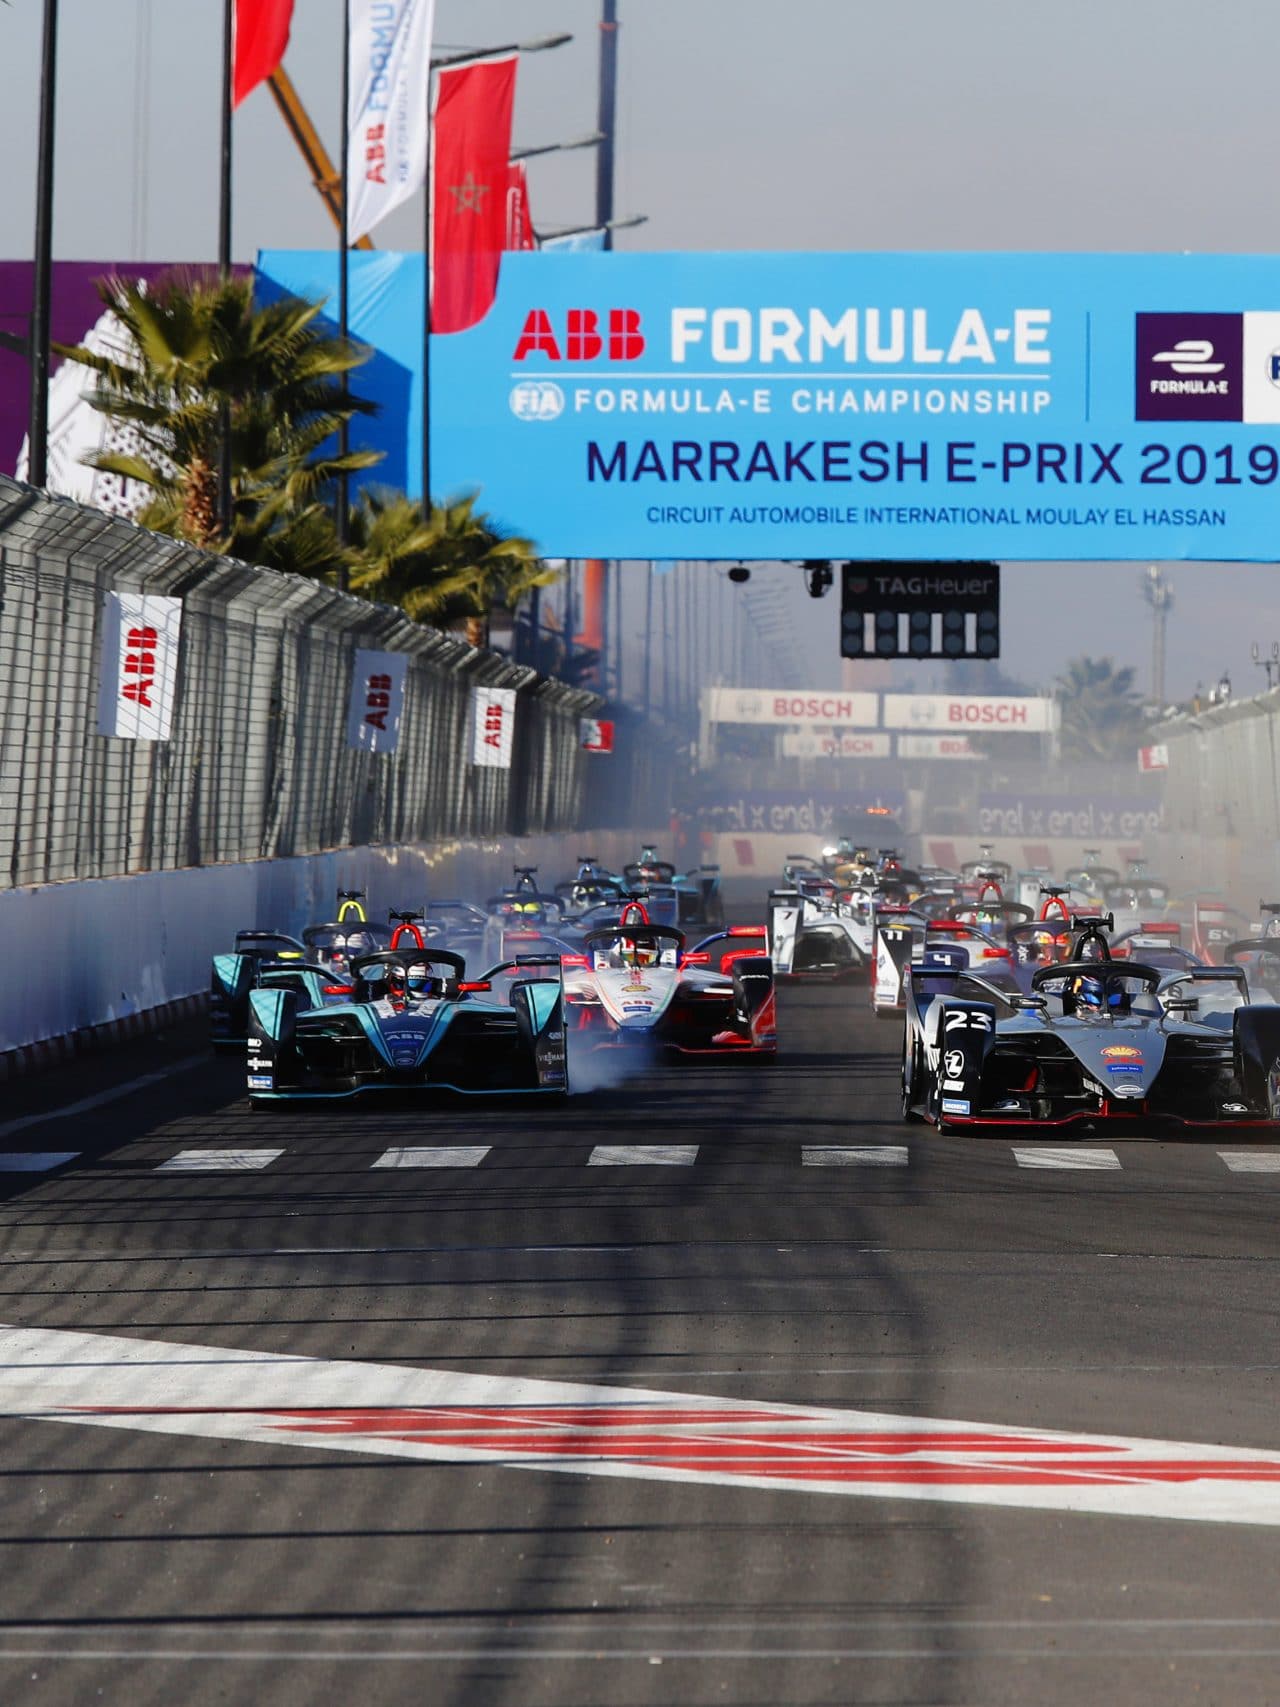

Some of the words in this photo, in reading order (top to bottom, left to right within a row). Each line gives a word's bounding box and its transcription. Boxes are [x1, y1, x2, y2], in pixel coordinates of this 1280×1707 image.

[366, 124, 386, 184] ABB
[512, 309, 645, 361] ABB
[671, 308, 1051, 364] FORMULA-E
[1150, 379, 1229, 394] FORMULA-E
[575, 389, 771, 413] FORMULA-E
[791, 389, 1051, 414] CHAMPIONSHIP
[587, 440, 928, 482] MARRAKESH
[947, 441, 1124, 484] E-PRIX
[1139, 443, 1280, 485] 2019
[646, 506, 724, 524] CIRCUIT
[729, 506, 858, 525] AUTOMOBILE
[864, 507, 1020, 525] INTERNATIONAL
[1026, 508, 1111, 526] MOULAY
[1115, 509, 1138, 526] EL
[1143, 509, 1226, 527] HASSAN
[121, 626, 158, 708] ABB
[364, 672, 391, 731] ABB
[773, 698, 853, 718] BOSCH
[948, 704, 1027, 723] BOSCH
[483, 704, 502, 748] ABB
[885, 930, 903, 941] 11
[933, 954, 951, 966] 4
[945, 1010, 992, 1032] 23
